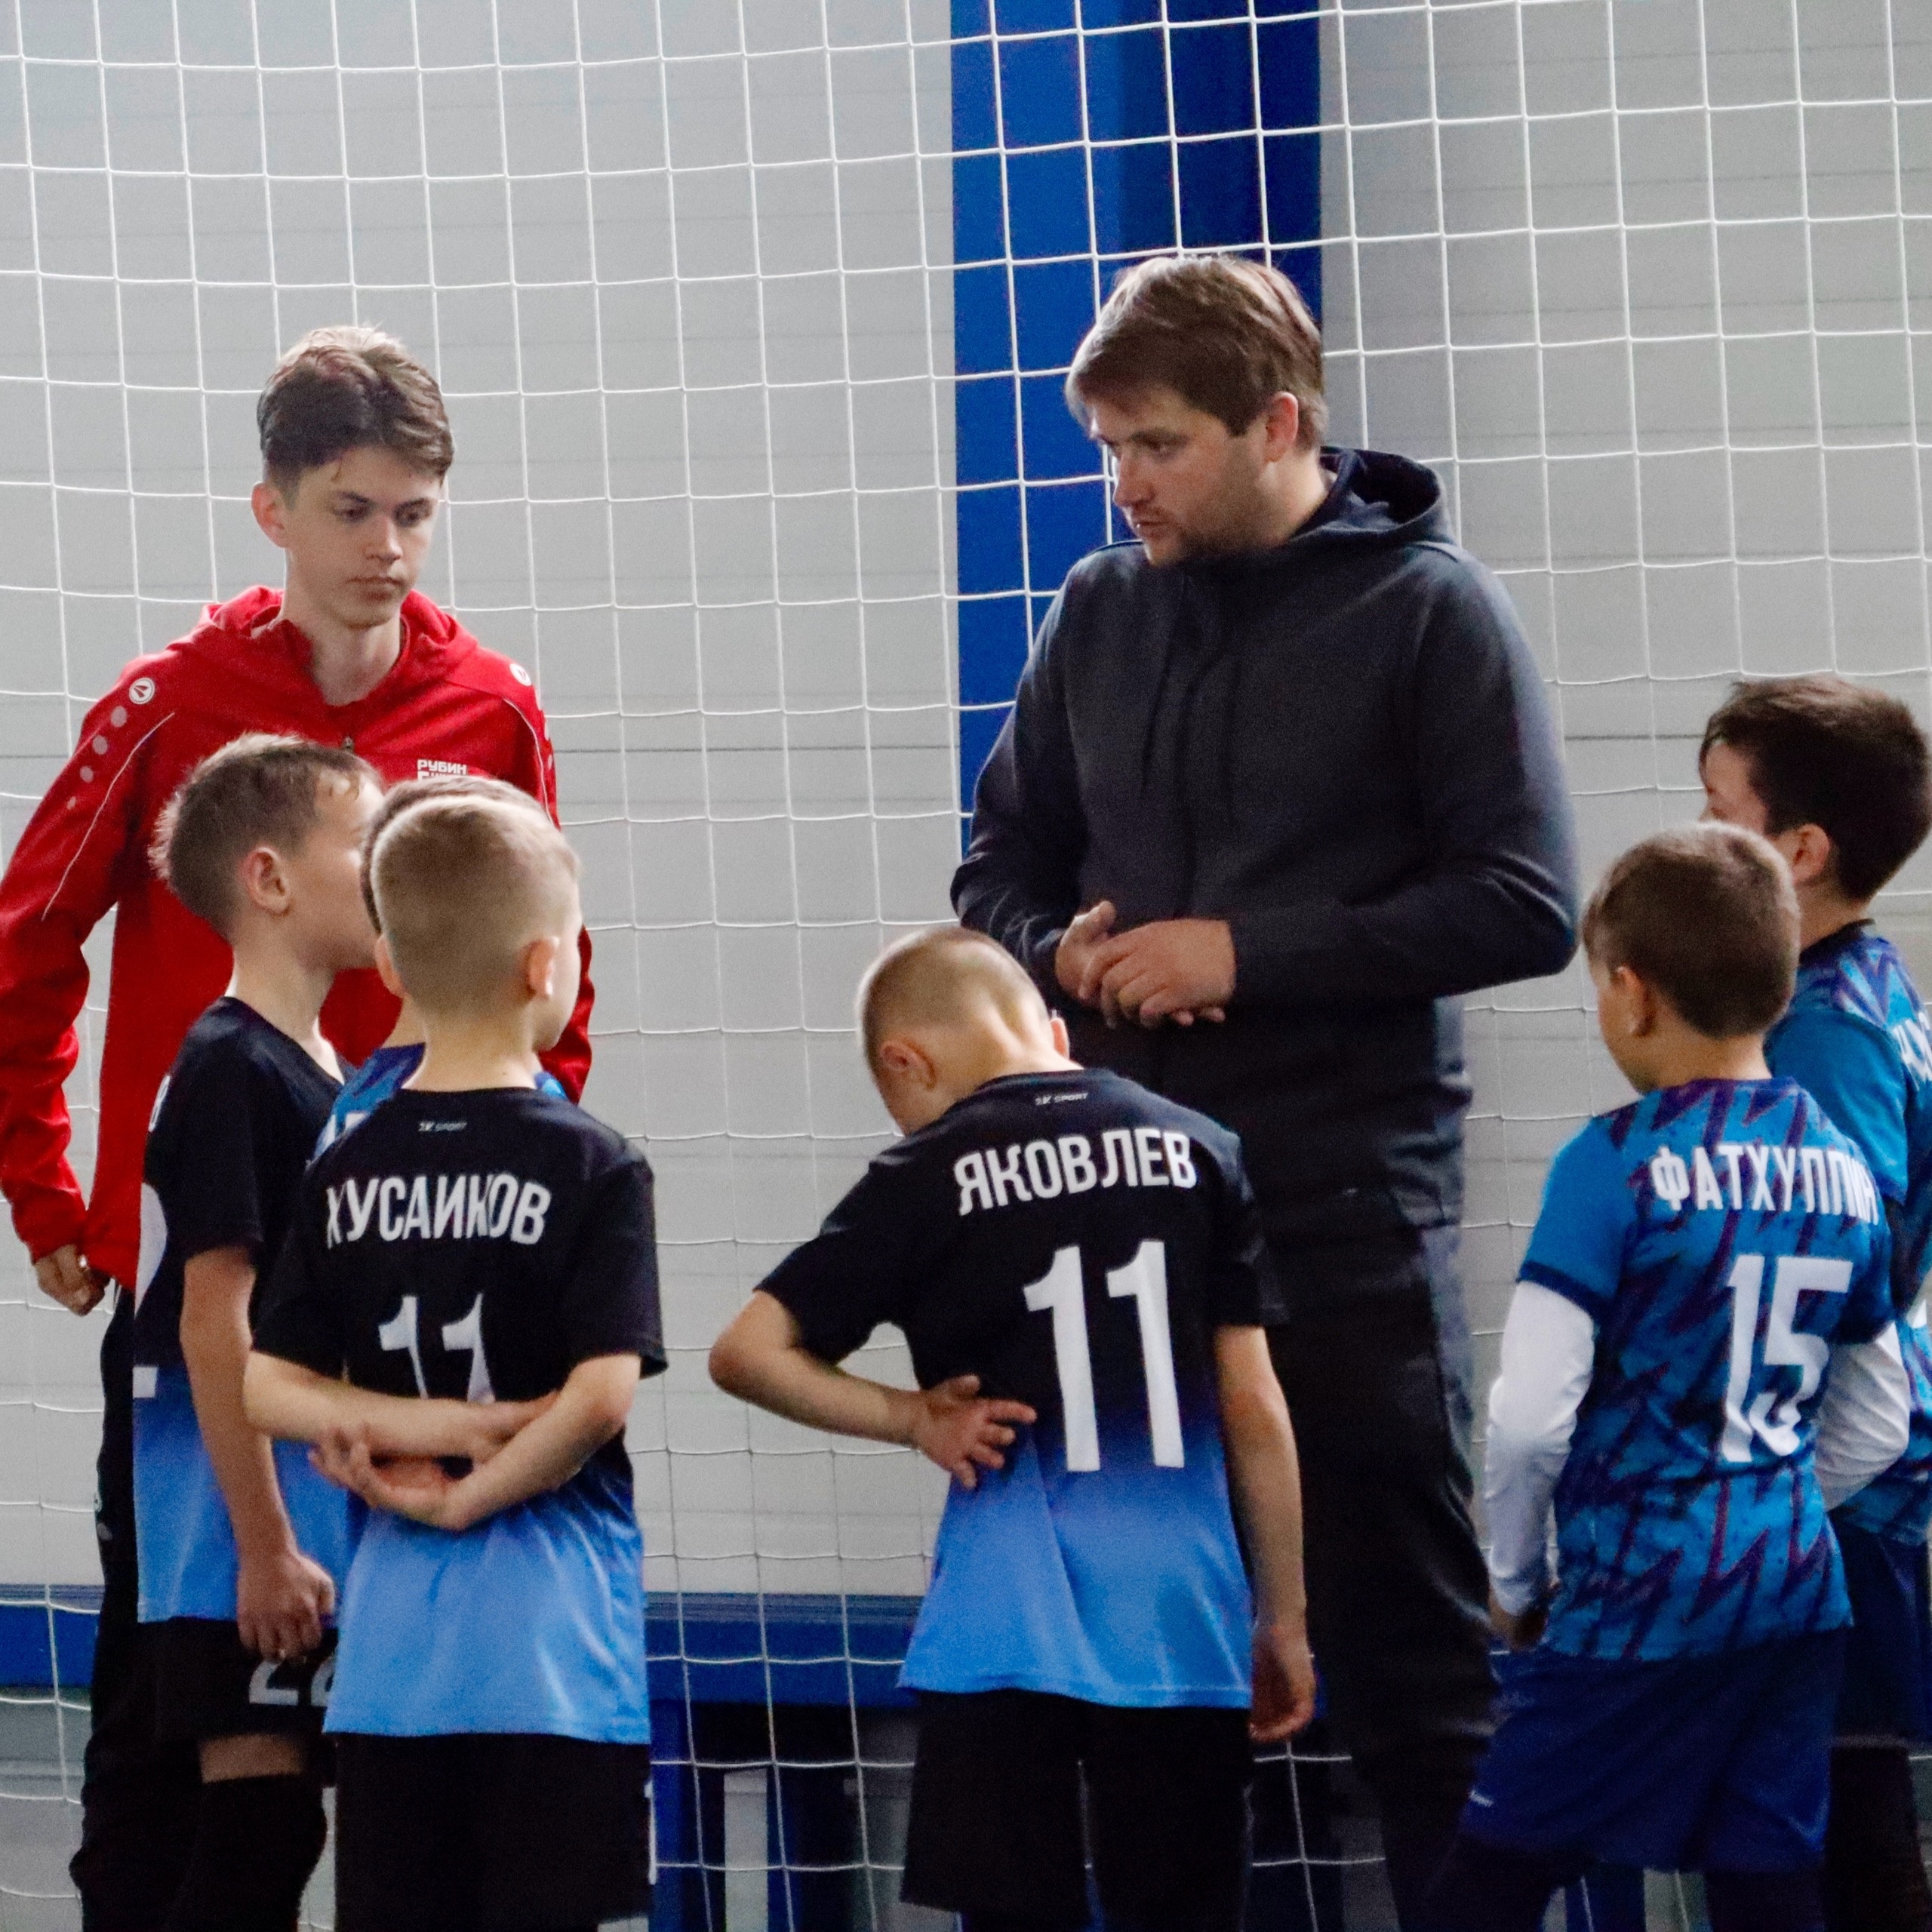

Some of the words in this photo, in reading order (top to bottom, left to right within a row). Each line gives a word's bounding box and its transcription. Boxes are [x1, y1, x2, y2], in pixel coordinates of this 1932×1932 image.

[417, 759, 467, 776] РУБИН
[953, 1128, 1198, 1217] ЯКОВЛЕВ
[378, 1292, 497, 1404] 11
[1023, 1239, 1186, 1472] 11
[1720, 1254, 1854, 1463] 15
